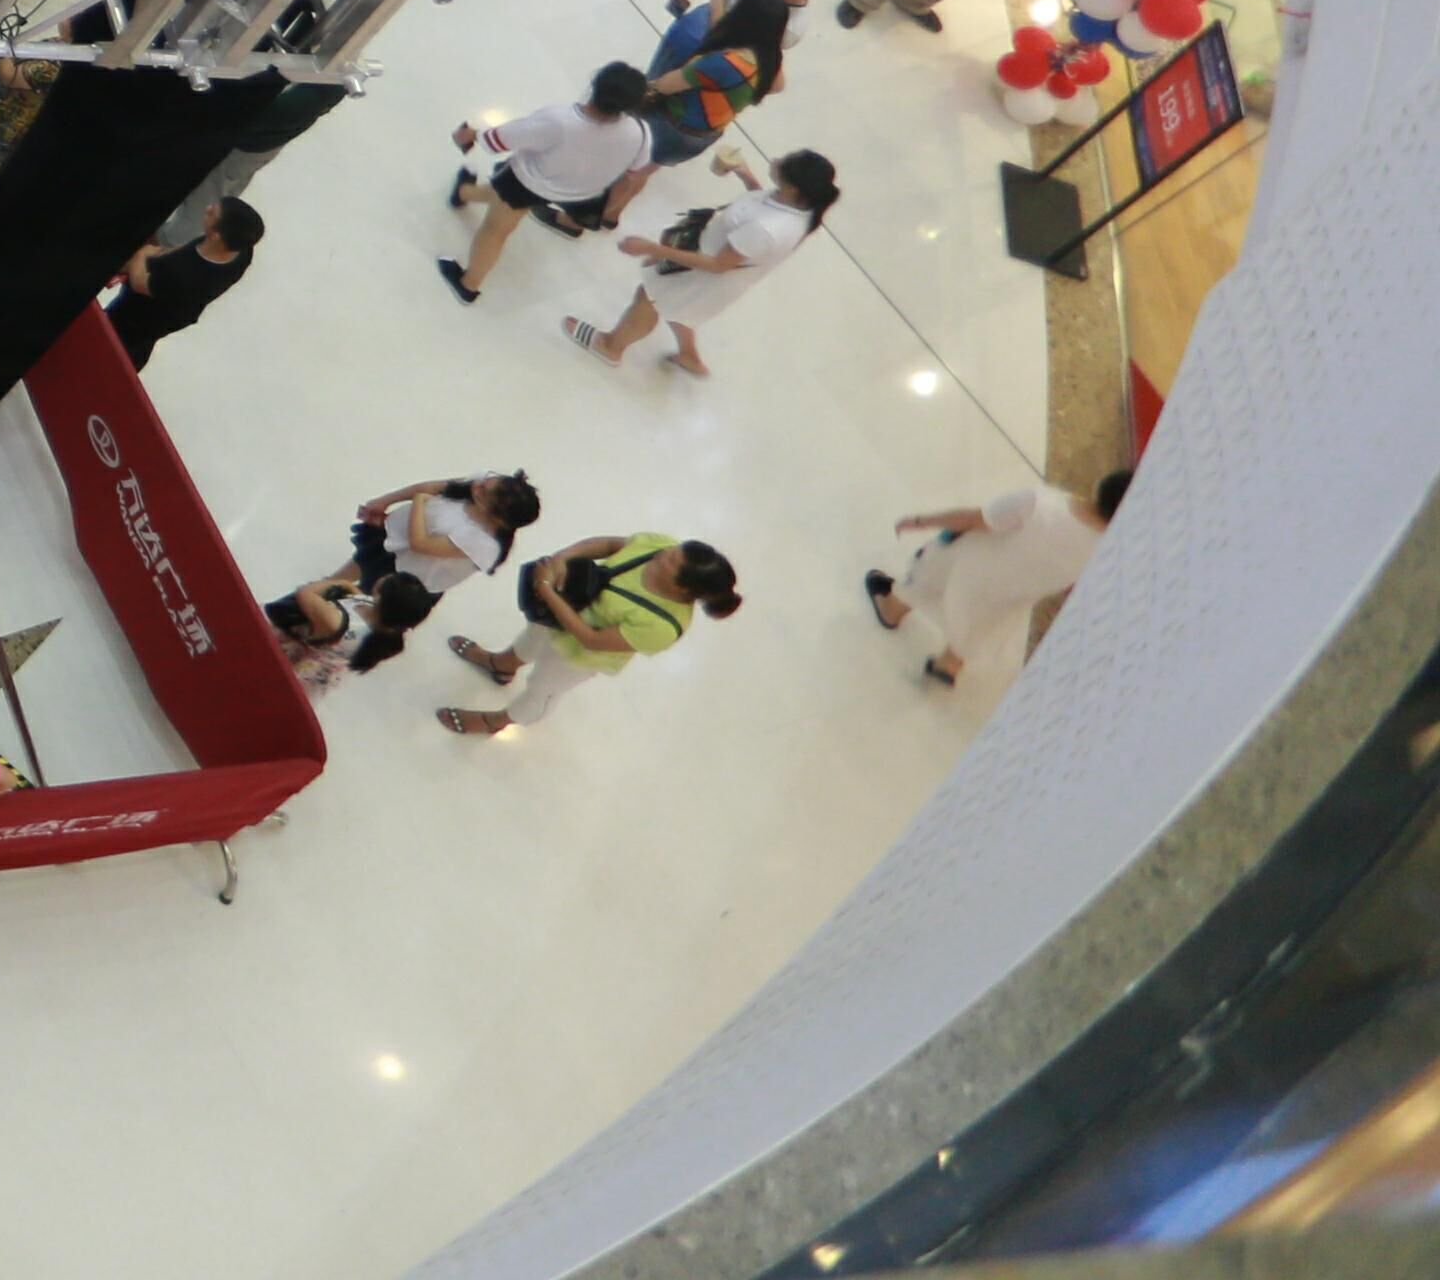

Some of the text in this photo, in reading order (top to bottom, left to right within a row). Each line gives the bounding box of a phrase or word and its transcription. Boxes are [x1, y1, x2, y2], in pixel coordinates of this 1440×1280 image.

[116, 482, 150, 571] WANDA
[117, 466, 217, 657] 万达广场
